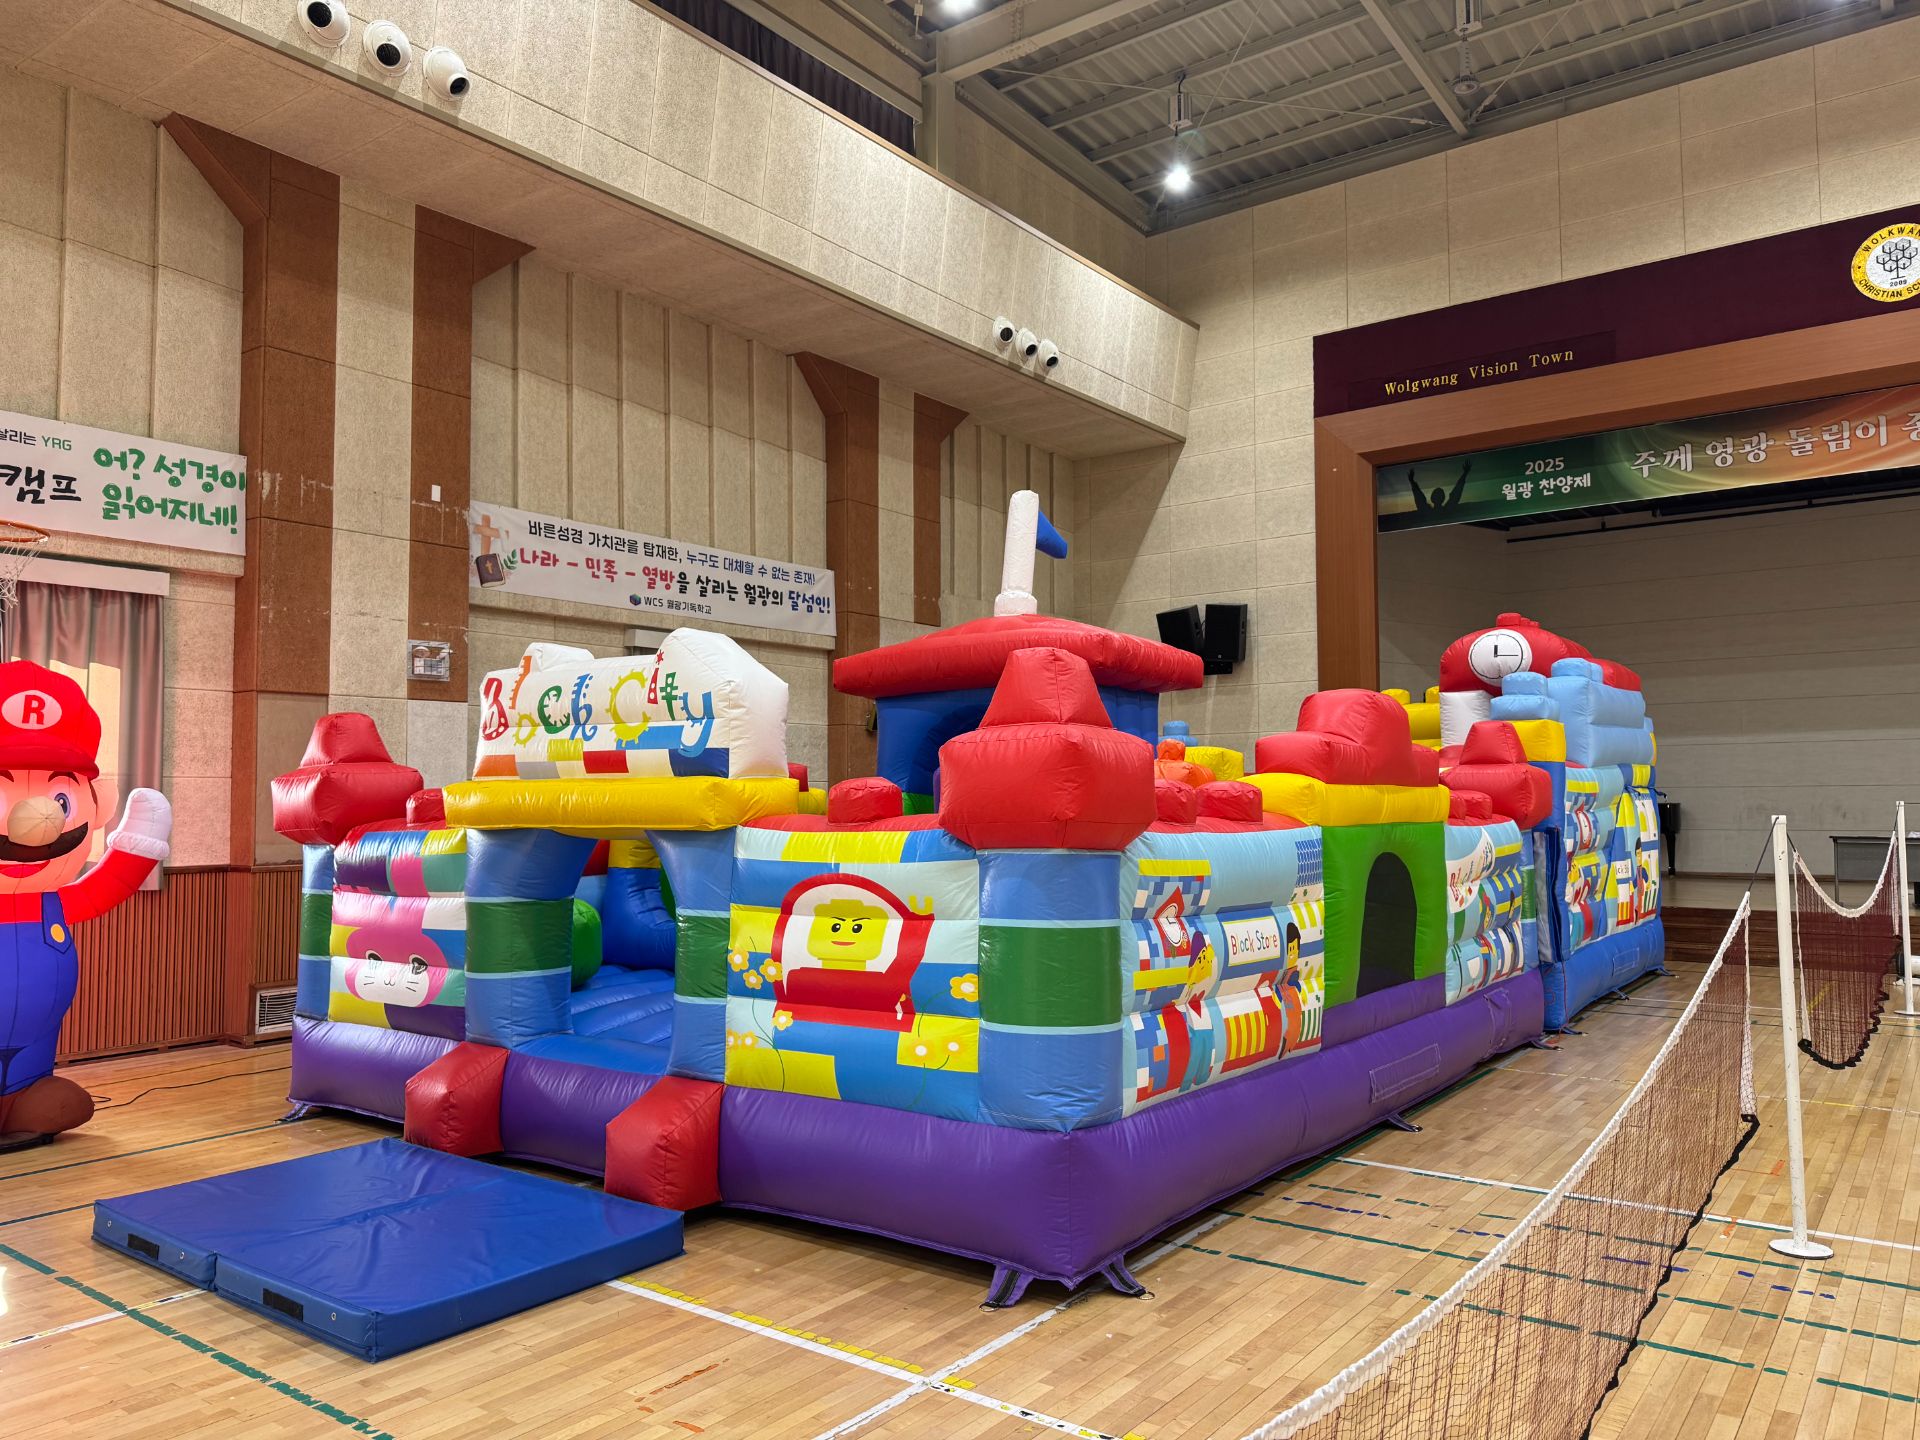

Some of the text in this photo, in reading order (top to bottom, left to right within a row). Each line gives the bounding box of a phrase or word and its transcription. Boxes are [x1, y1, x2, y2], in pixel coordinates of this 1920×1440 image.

[1859, 279, 1903, 298] CHRISTIAN
[1384, 350, 1574, 396] Wolgwang Vision Town
[41, 435, 72, 451] YRG
[1630, 443, 1693, 478] 주께
[1705, 431, 1775, 467] 영광
[1784, 415, 1888, 457] 돌림이
[93, 447, 246, 493] 어? 성경이
[1502, 472, 1591, 501] 월광 찬양제
[1524, 457, 1565, 476] 2025
[102, 482, 238, 535] 읽어지네!
[528, 520, 816, 586] 바른성경 가치관을 탑재한, 누구도 대체할 수 없는 존재!
[520, 547, 560, 568] 나라
[585, 557, 618, 583] 민족
[642, 566, 690, 595] 열방을
[695, 575, 739, 602] 살리는
[743, 583, 784, 607] 월광의
[787, 590, 831, 615] 달섬인!
[643, 596, 712, 616] WCS 월광기독학교
[21, 694, 46, 725] R
[481, 649, 716, 759] Block City
